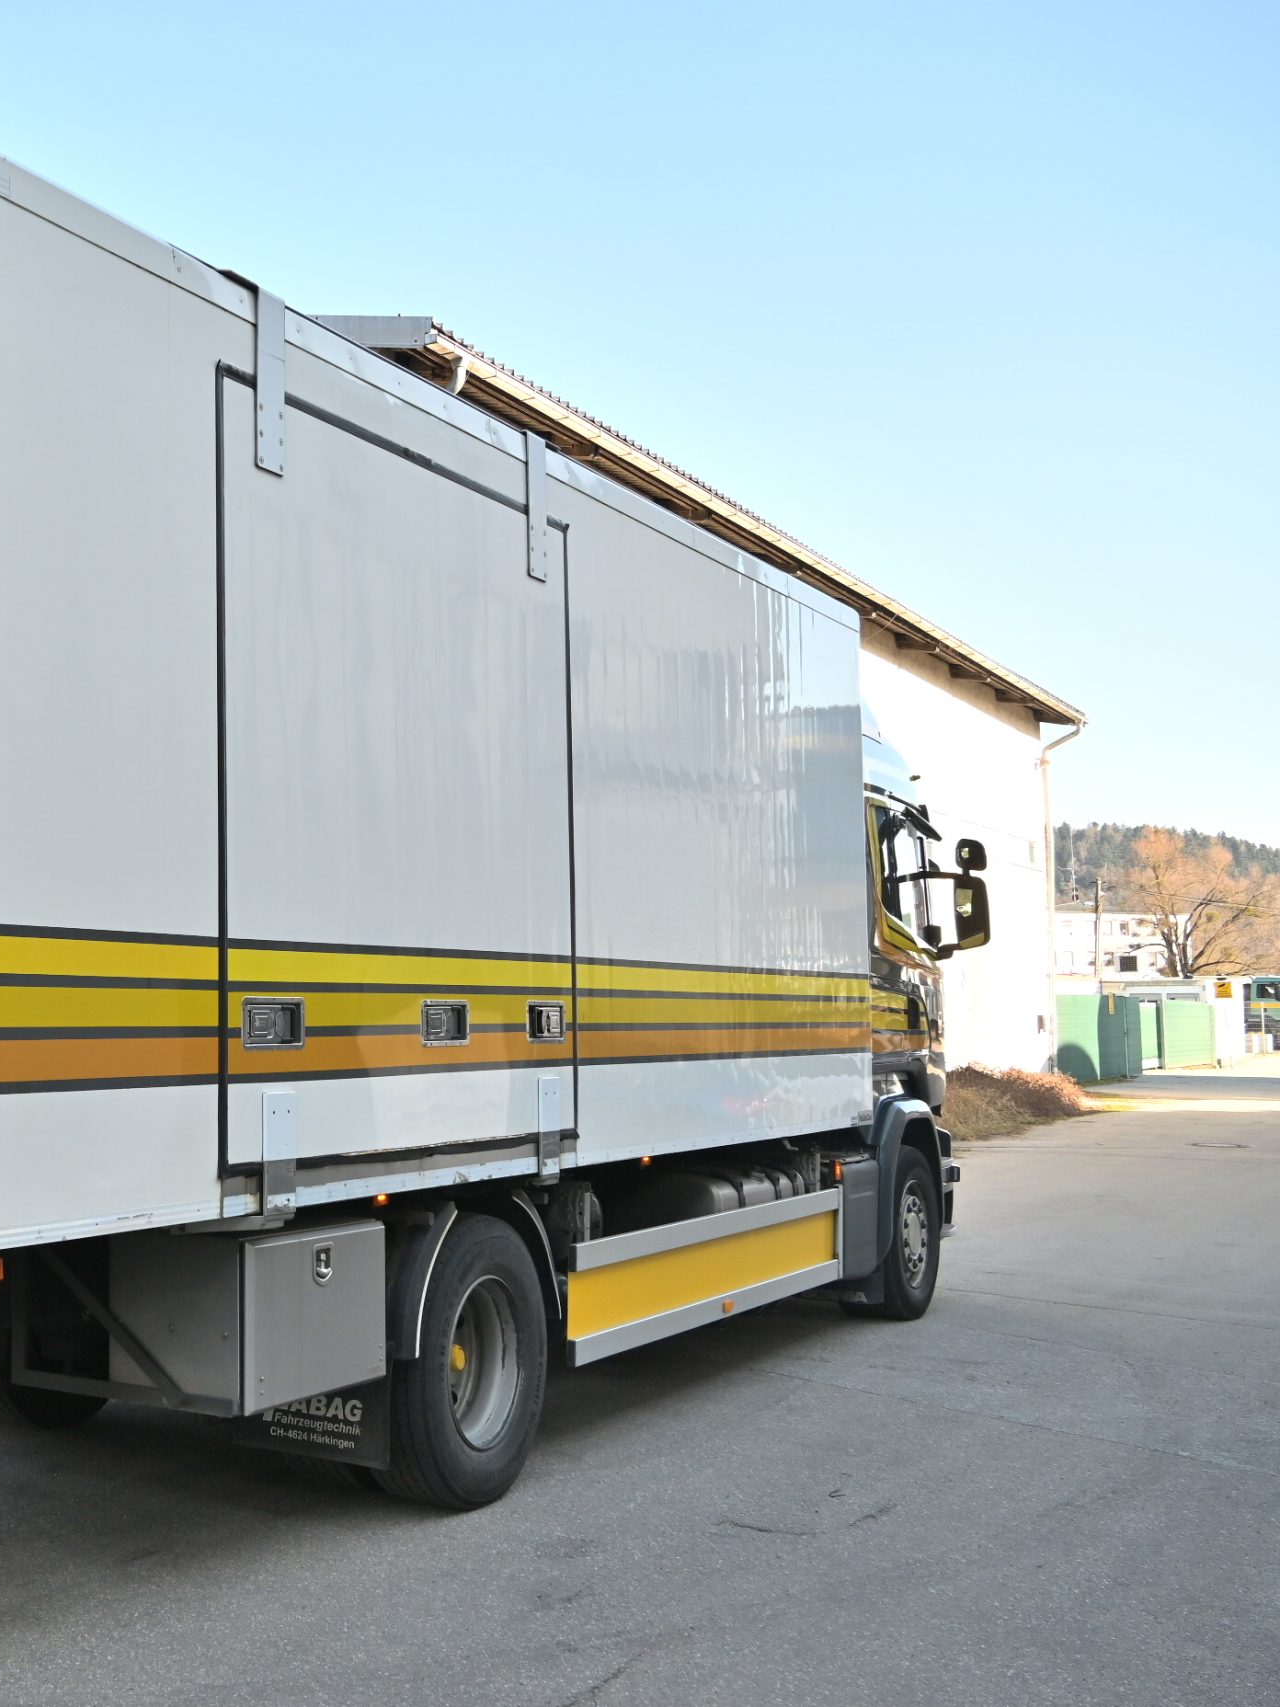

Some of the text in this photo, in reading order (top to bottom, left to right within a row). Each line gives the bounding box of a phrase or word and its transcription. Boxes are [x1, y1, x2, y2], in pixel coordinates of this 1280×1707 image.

[263, 1395, 362, 1422] ABAG
[274, 1412, 361, 1436] Fahrzeugtechnik
[270, 1426, 355, 1449] CH-4624 Härkingen
